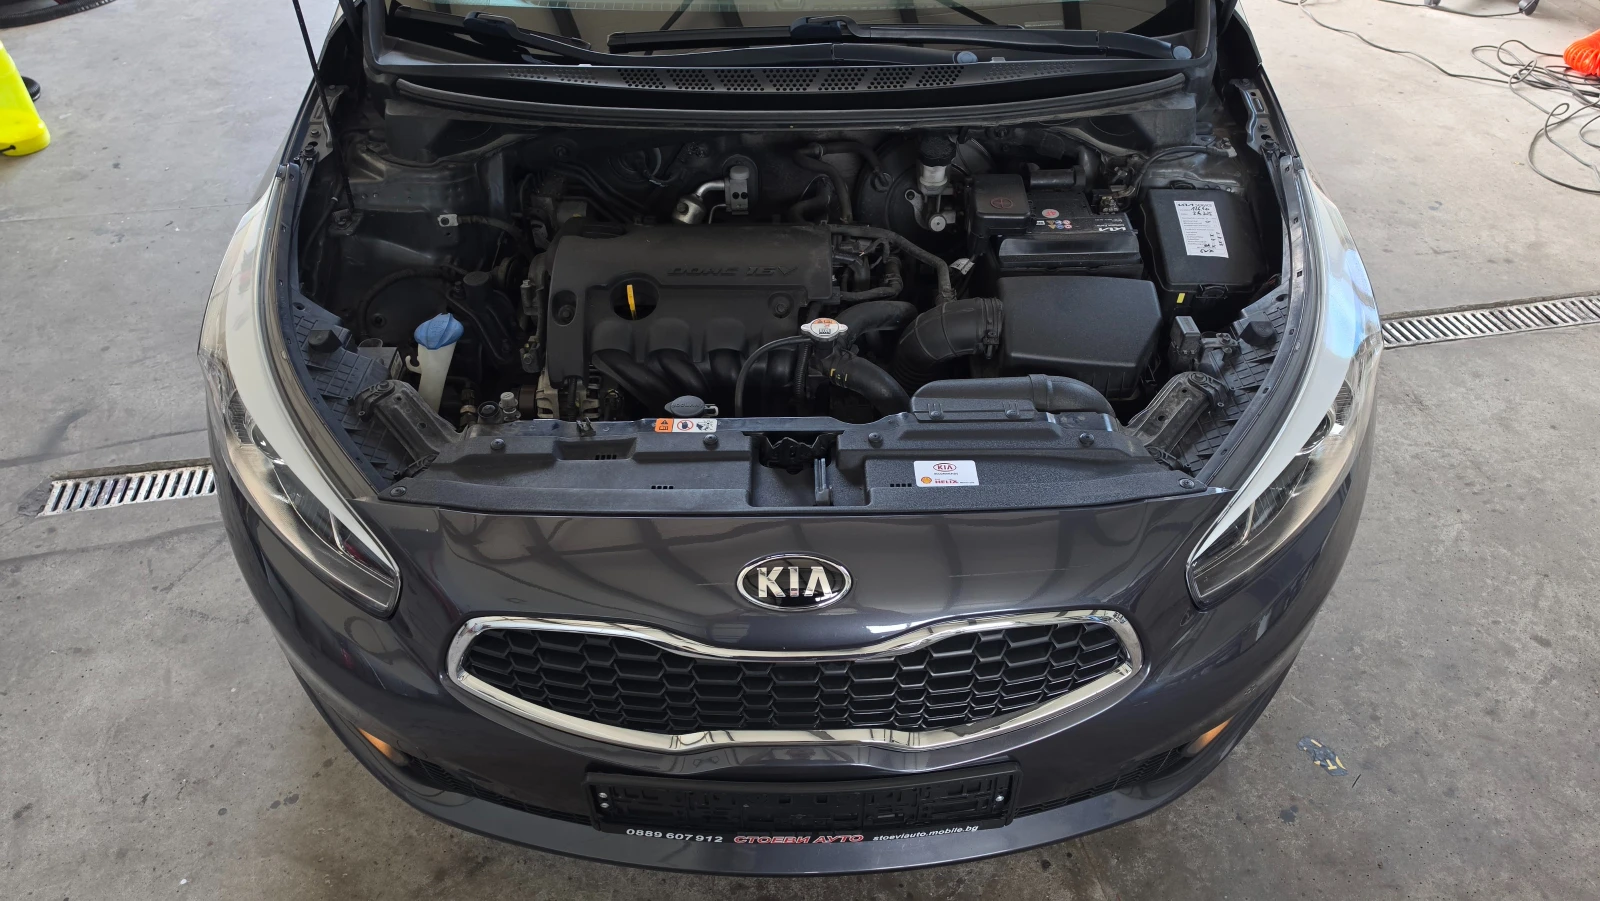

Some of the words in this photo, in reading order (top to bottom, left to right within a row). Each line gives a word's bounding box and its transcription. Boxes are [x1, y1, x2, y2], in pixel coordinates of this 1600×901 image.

[745, 265, 799, 277] 16V
[756, 566, 833, 598] KIA
[626, 828, 663, 838] 0889
[665, 832, 693, 841] 607
[695, 835, 723, 843] 912
[734, 835, 811, 844] СТОЕВИ
[873, 825, 979, 841] stoeviauto.mobile.bg
